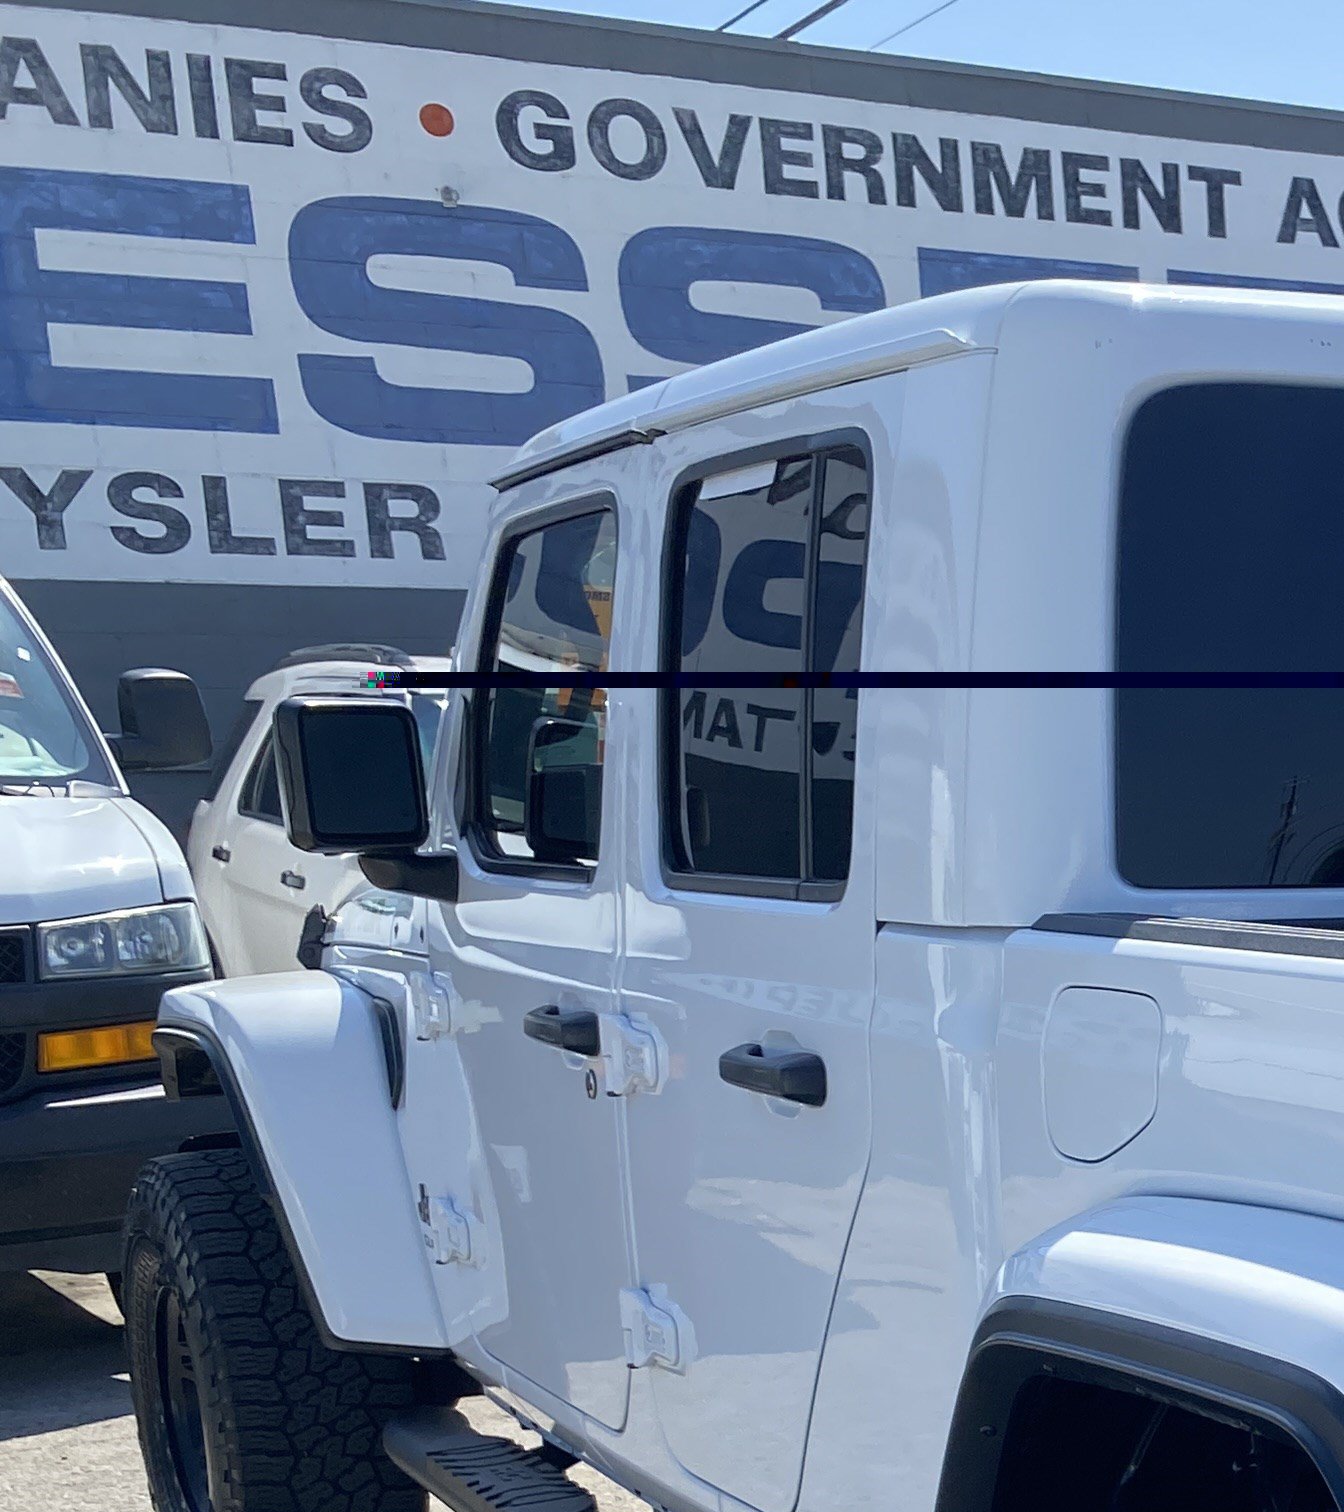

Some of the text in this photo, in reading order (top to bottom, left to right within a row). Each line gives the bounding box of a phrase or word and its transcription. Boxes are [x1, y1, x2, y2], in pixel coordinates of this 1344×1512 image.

[0, 37, 373, 153] ANIES
[495, 89, 1241, 240] GOVERNMENT
[0, 467, 447, 560] YSLER
